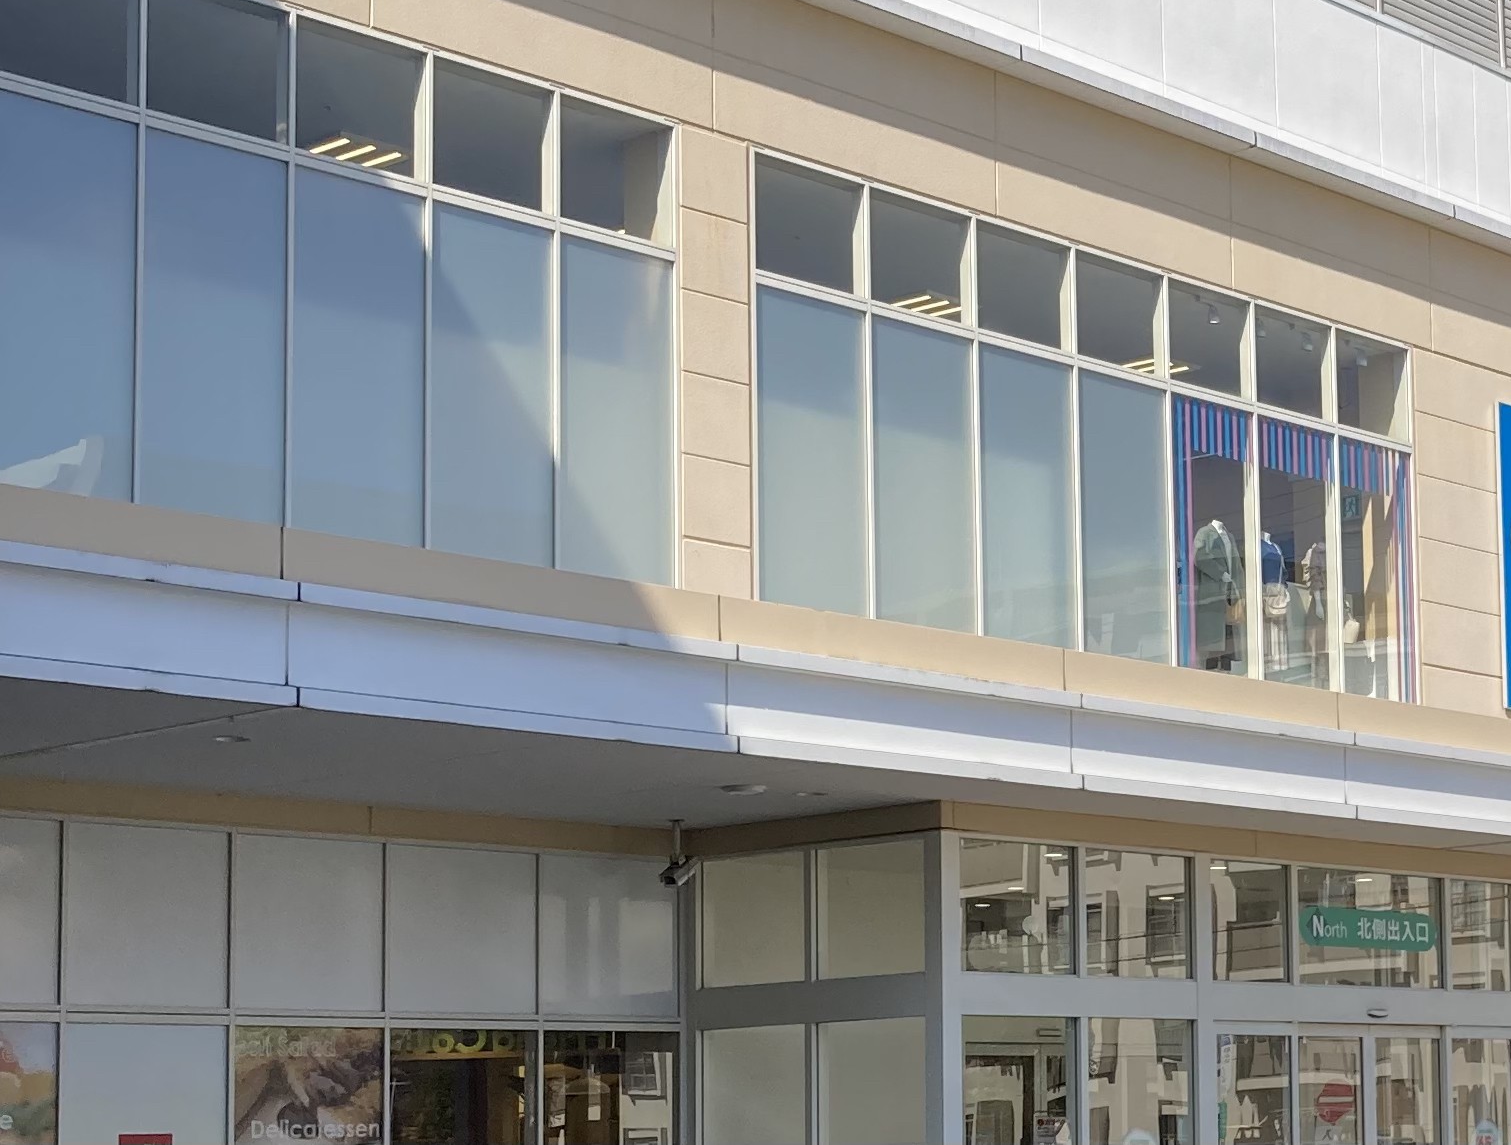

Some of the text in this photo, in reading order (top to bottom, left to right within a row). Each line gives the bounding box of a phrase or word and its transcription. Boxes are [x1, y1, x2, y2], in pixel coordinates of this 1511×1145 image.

[1312, 915, 1348, 939] North
[1357, 916, 1429, 943] 北側出入口
[251, 1119, 380, 1140] Delicatessen
